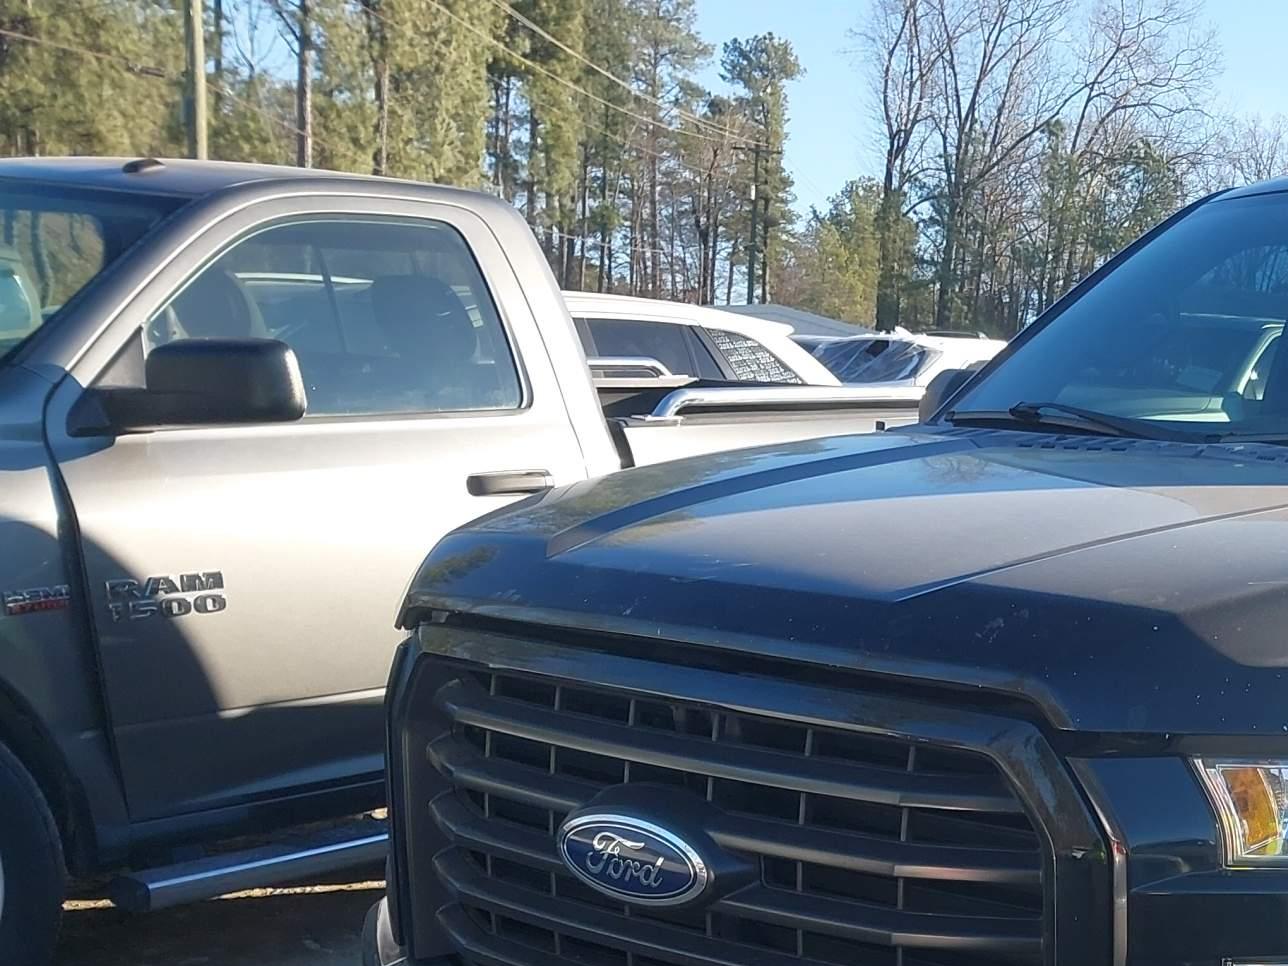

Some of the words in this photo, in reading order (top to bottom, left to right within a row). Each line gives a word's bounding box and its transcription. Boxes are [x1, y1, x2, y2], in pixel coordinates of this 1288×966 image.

[105, 571, 225, 600] RAM
[108, 594, 227, 623] 1500
[585, 831, 665, 888] Ford
